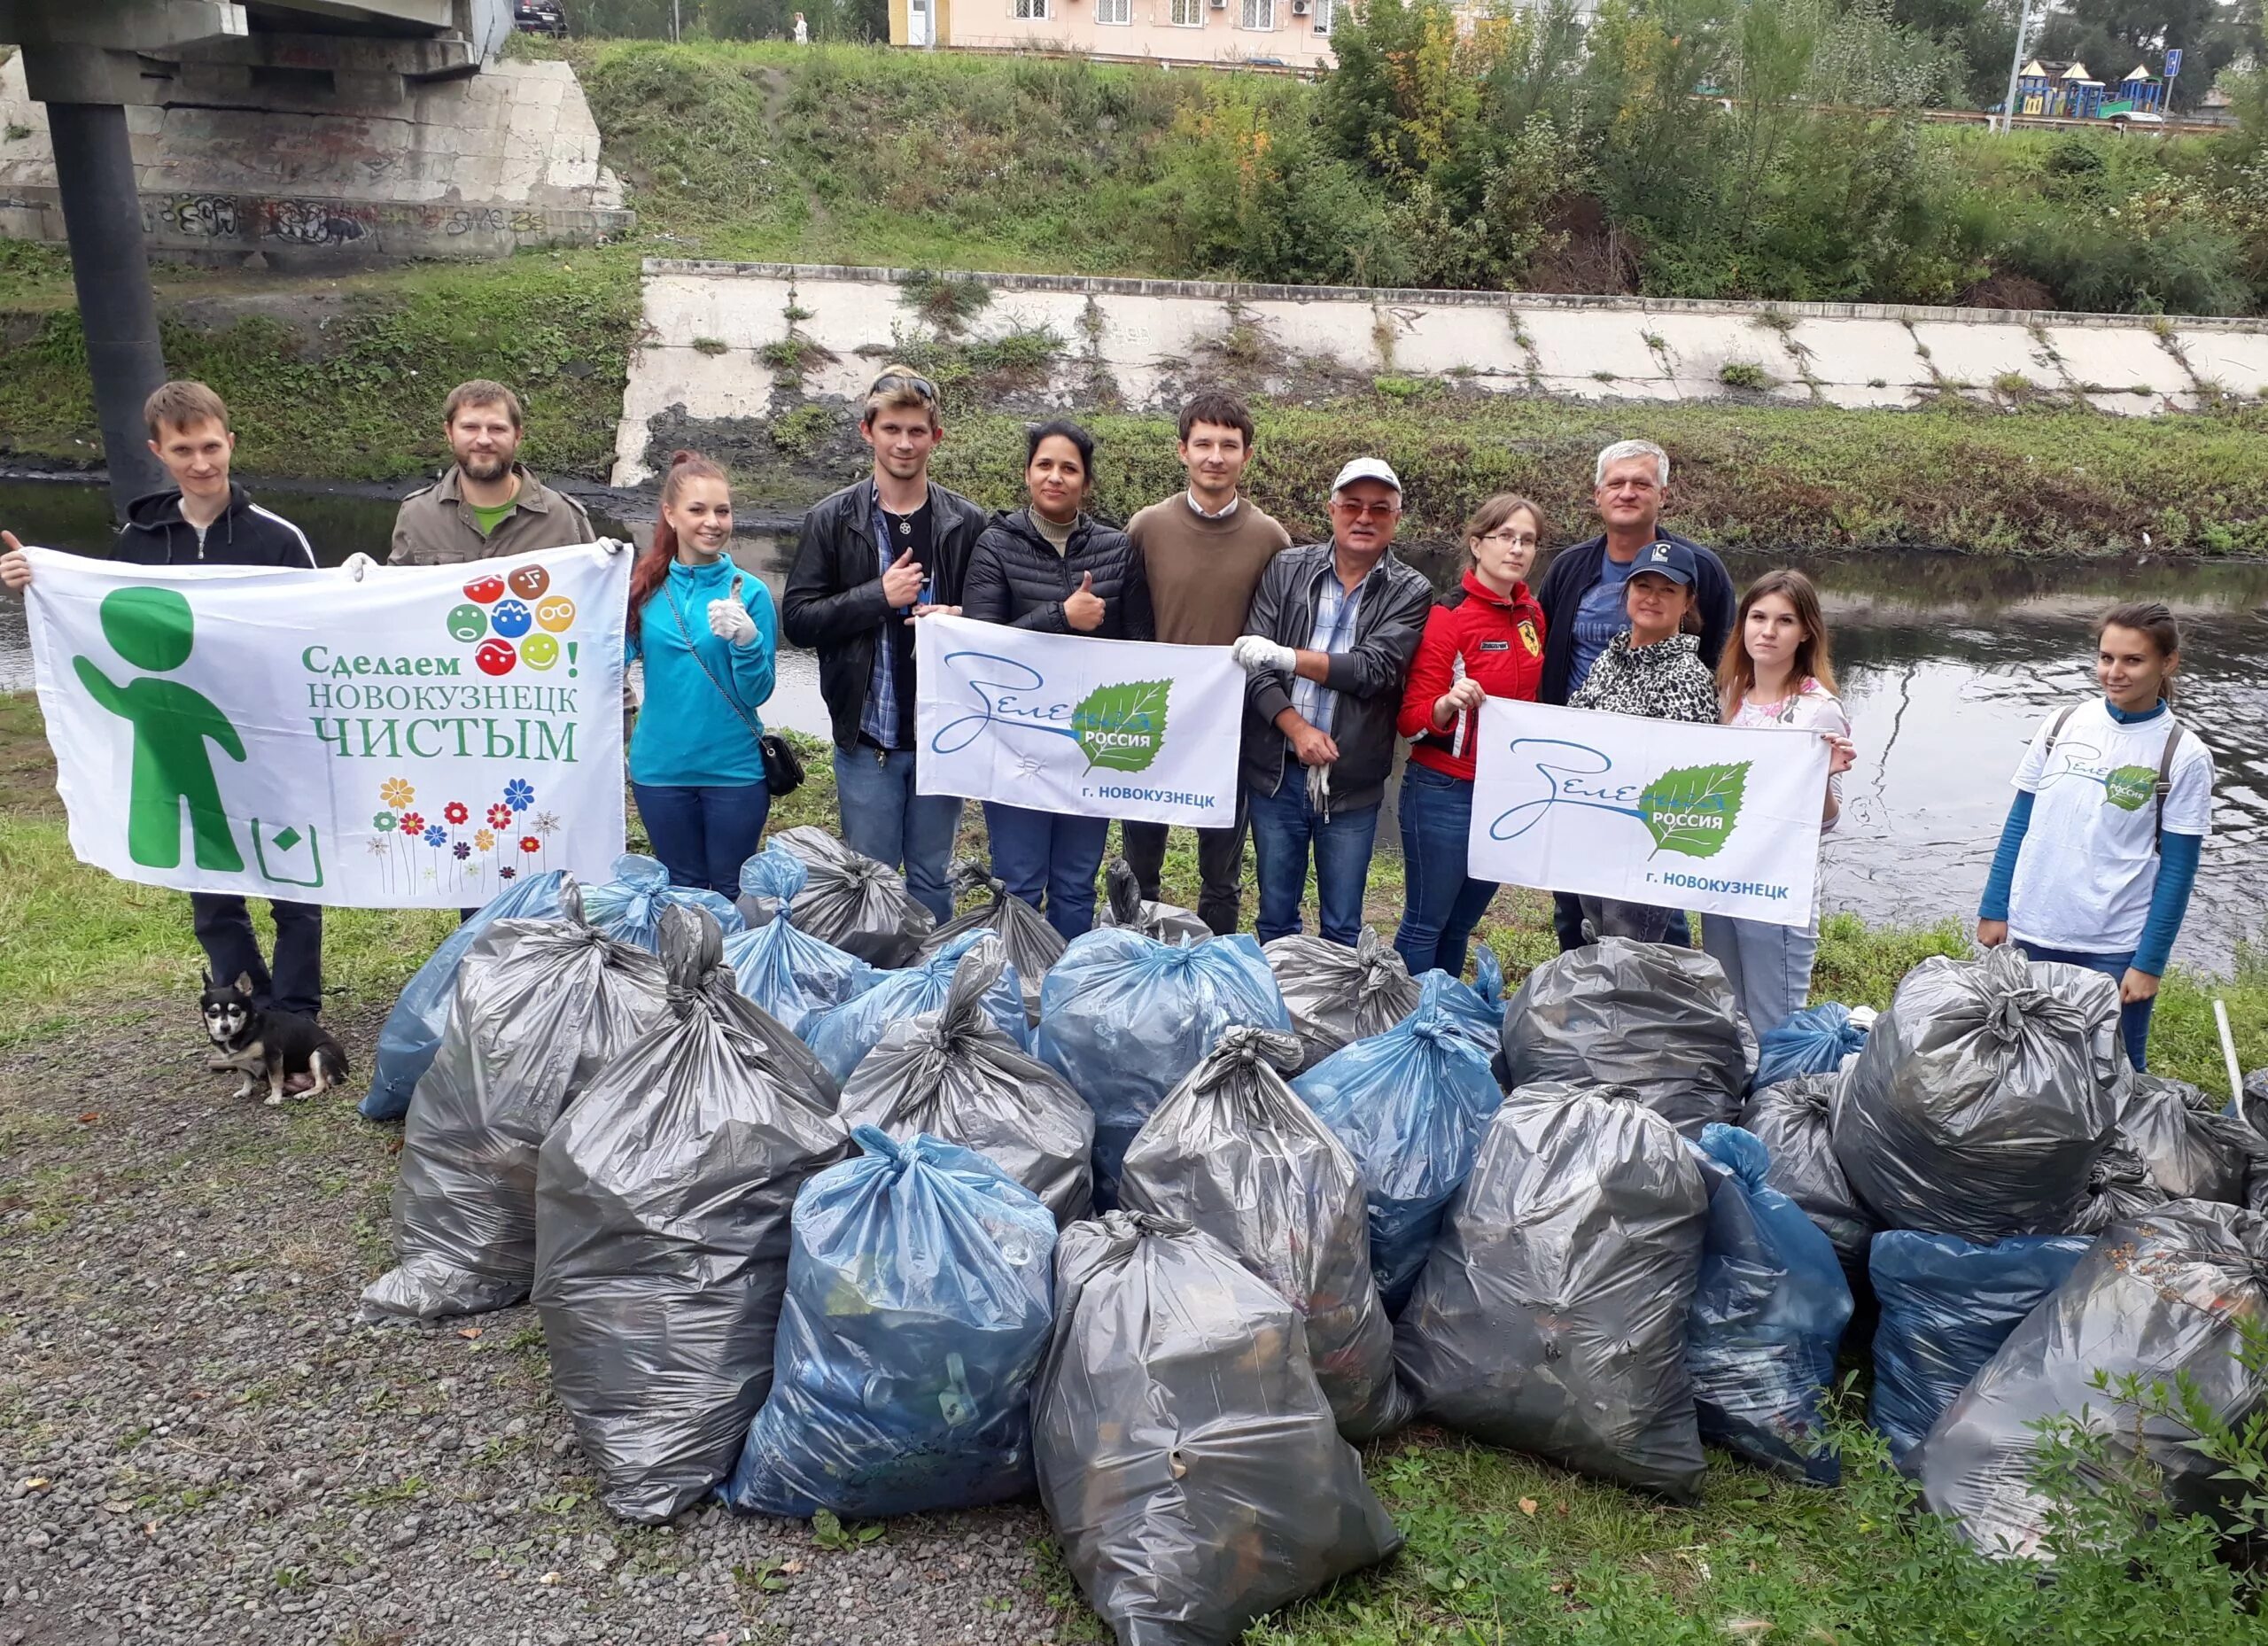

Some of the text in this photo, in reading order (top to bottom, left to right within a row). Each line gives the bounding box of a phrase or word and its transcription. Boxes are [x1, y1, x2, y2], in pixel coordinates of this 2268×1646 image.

[302, 646, 461, 679] Сделаем
[307, 683, 579, 716] НОВОКУЗНЕЦК
[310, 716, 579, 762] ЧИСТЫМ
[1084, 731, 1151, 748] РОССИЯ
[1082, 786, 1216, 809] г. НОВОКУЗНЕЦК
[2109, 783, 2145, 800] РОССИЯ
[1652, 811, 1723, 830] РОССИЯ
[1646, 872, 1789, 900] г. НОВОКУЗНЕЦК
